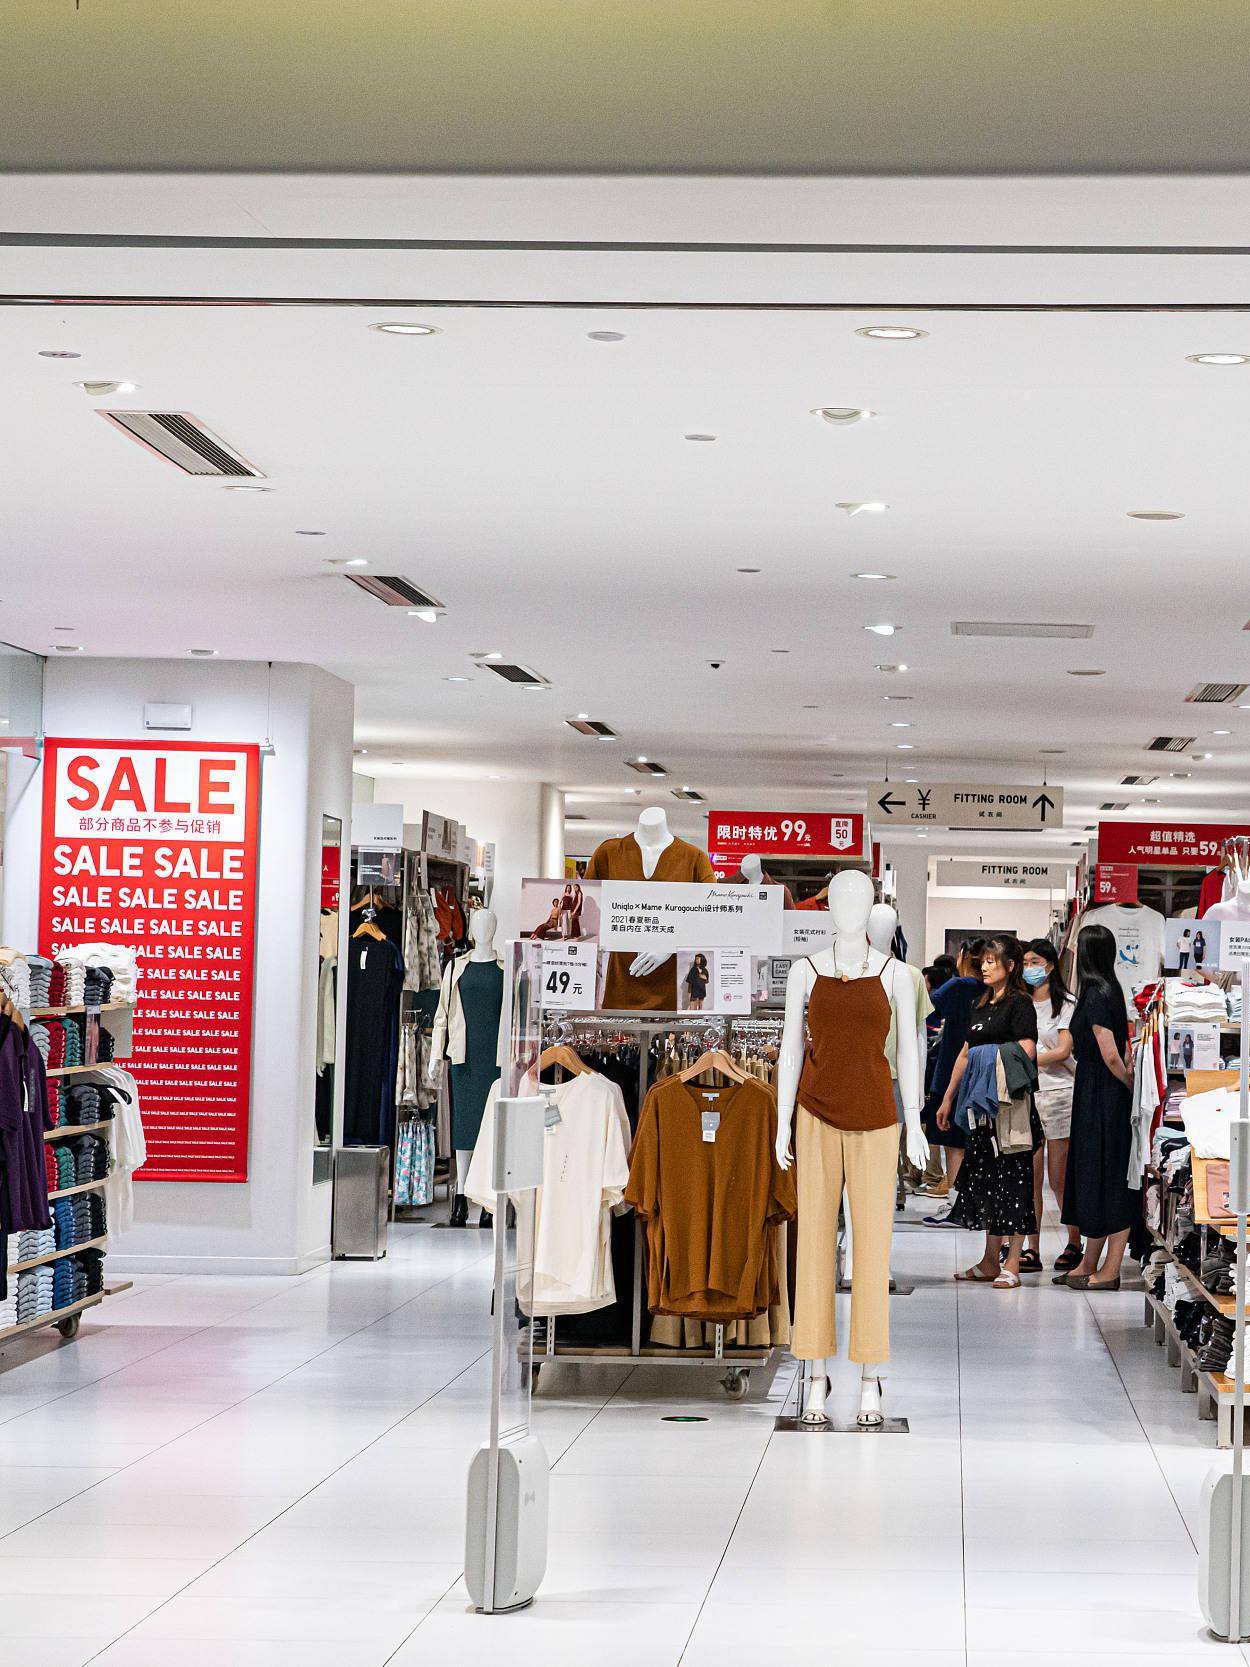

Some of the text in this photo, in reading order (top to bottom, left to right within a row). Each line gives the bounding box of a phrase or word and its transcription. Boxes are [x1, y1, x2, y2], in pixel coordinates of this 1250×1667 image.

[67, 755, 235, 814] SALE
[953, 793, 1028, 805] FITTING ROOM
[910, 812, 937, 820] CASHIER
[78, 816, 220, 835] 部分商品不参与促销
[835, 829, 848, 839] 50
[1150, 831, 1196, 843] 超值精选
[1128, 841, 1221, 856] 人气明星单品 只要59
[53, 844, 245, 879] SALE SALE
[981, 865, 1049, 876] FITTING ROOM
[53, 886, 243, 911] SALE SALE SALE
[611, 915, 660, 924] 2021春夏新品
[52, 918, 242, 936] SALE SALE SALE SALE
[168, 946, 202, 958] SALE
[206, 947, 241, 959] SALE
[147, 969, 240, 981] SALE SALE SALE
[160, 990, 185, 999] SALE
[187, 991, 212, 1000] SALE
[215, 992, 240, 1000] SALE
[132, 1010, 143, 1018] LE
[146, 1010, 167, 1018] SALE
[193, 1011, 215, 1019] SALE
